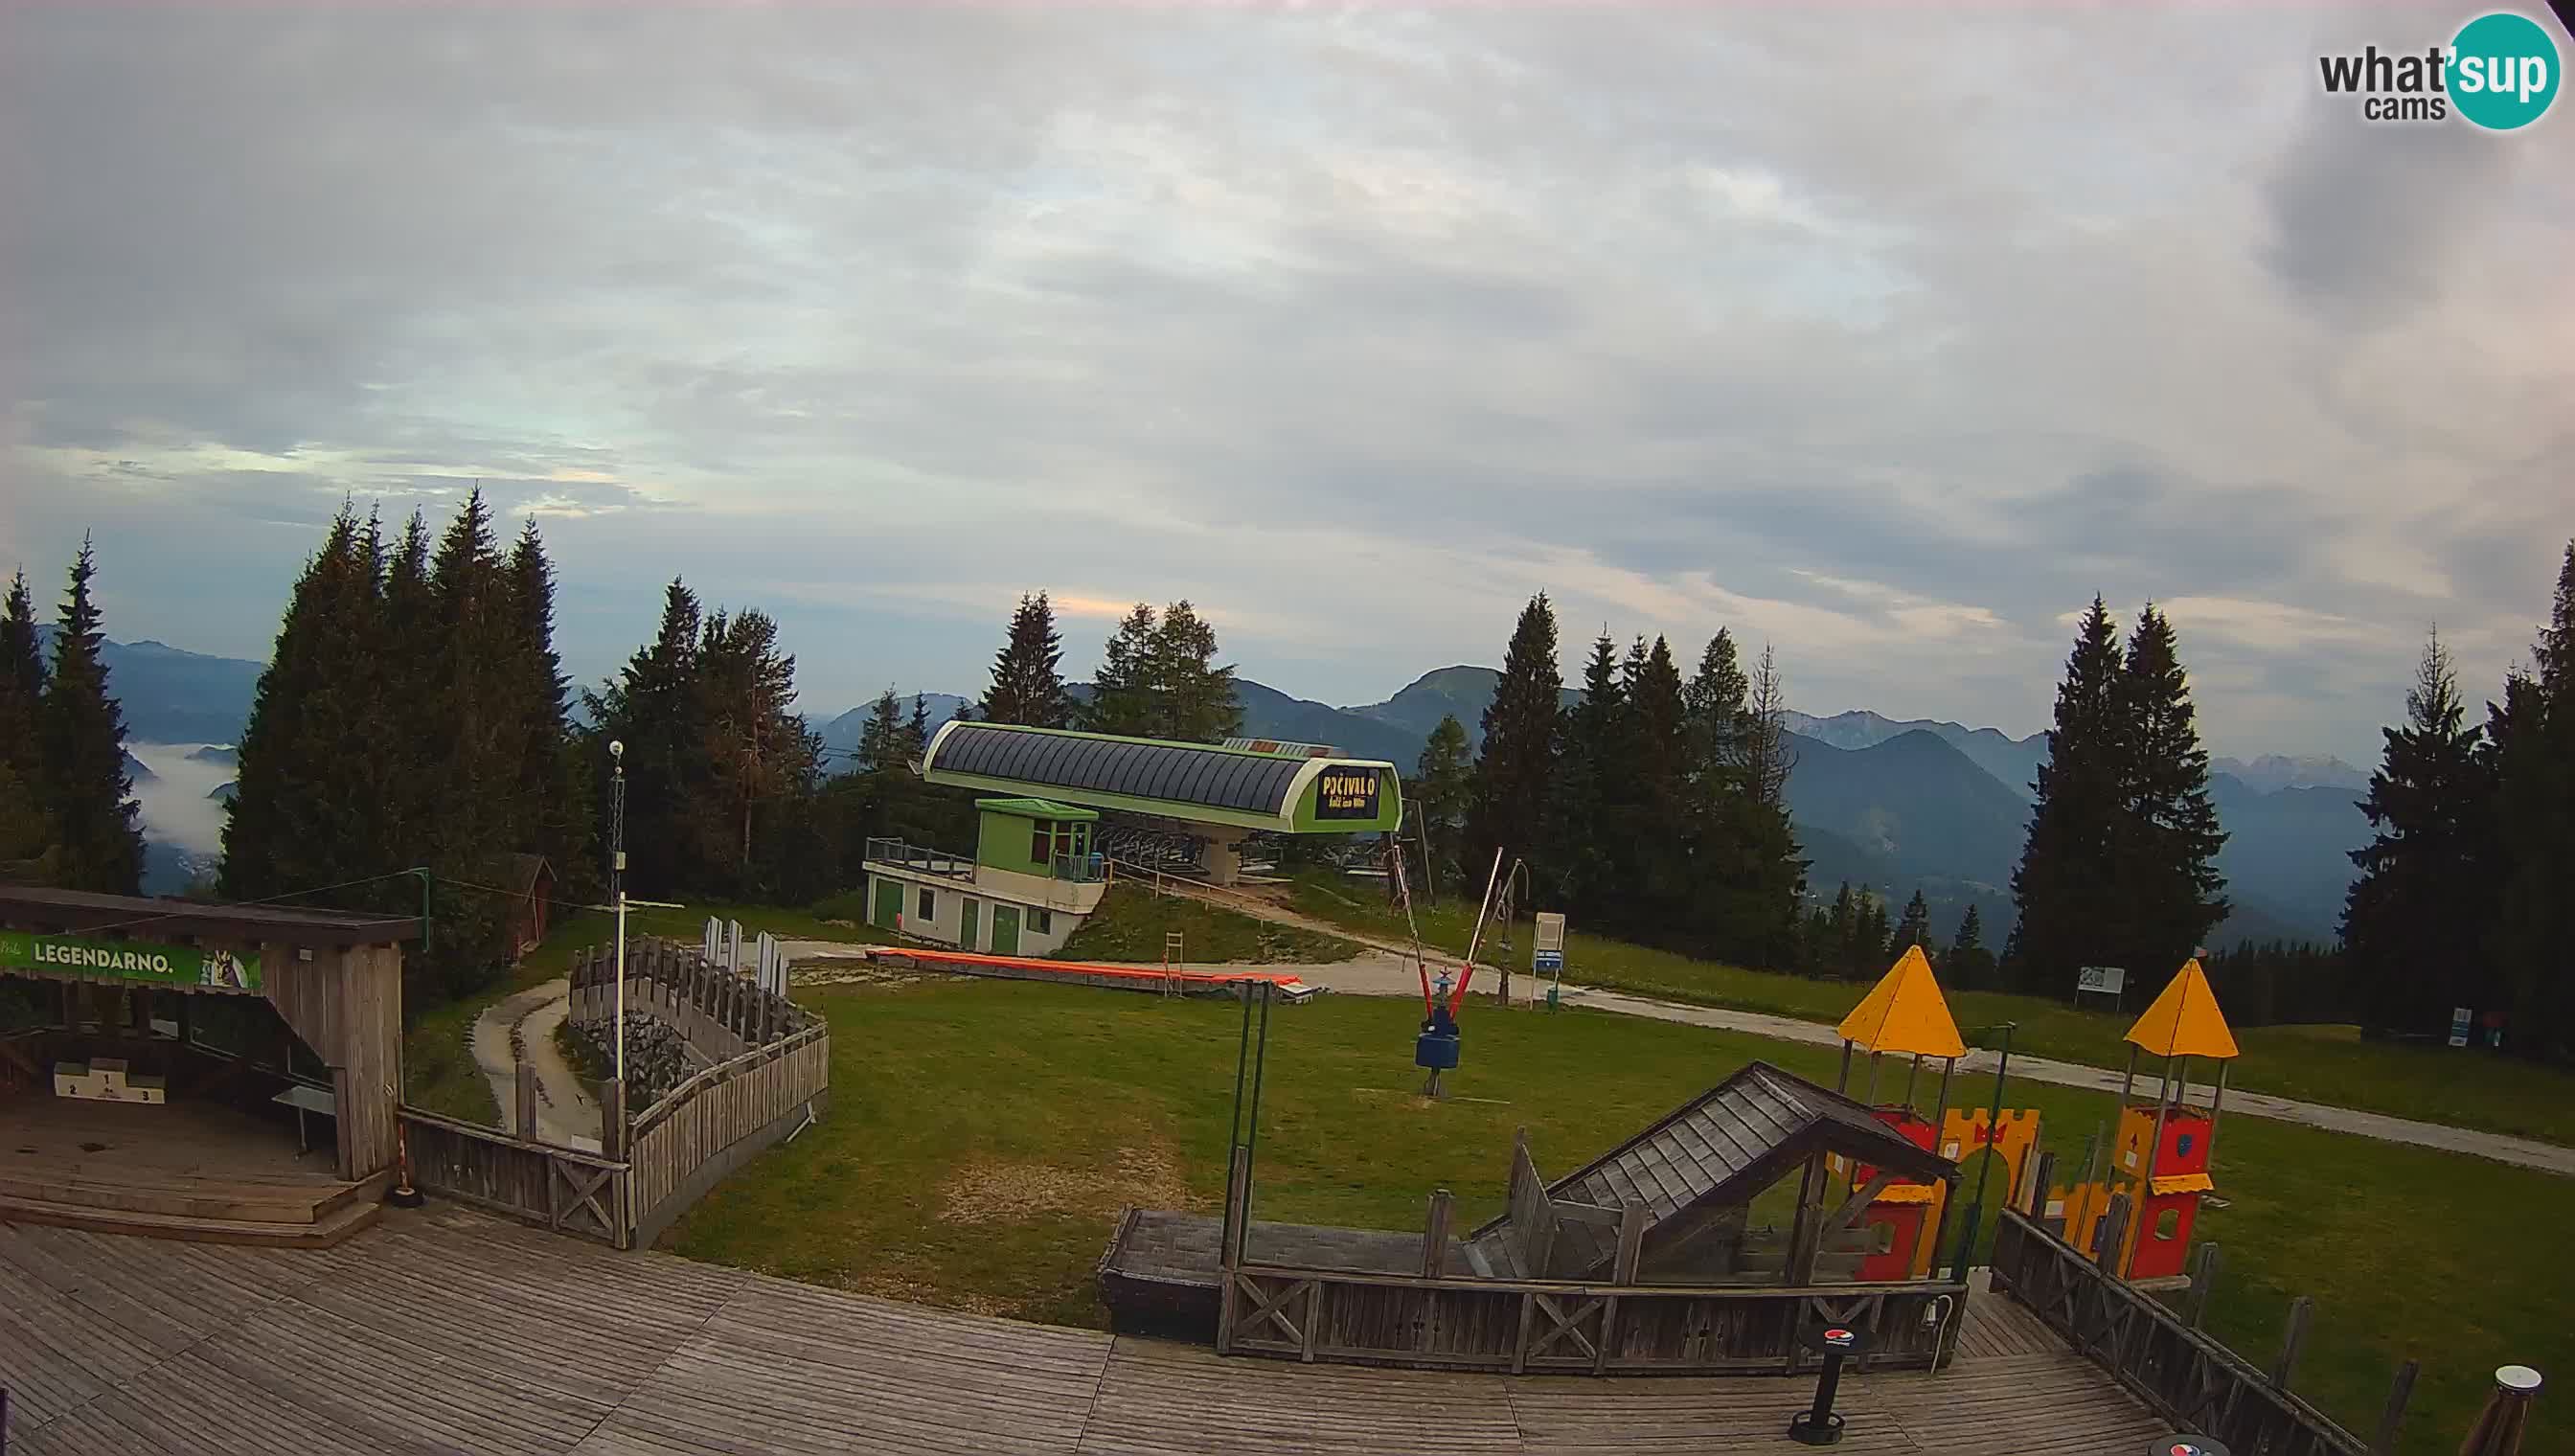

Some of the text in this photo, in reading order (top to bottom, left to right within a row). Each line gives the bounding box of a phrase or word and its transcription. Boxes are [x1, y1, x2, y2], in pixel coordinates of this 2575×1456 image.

[34, 943, 173, 973] LEGENDARNO.
[103, 1073, 110, 1084] 1
[69, 1084, 77, 1095] 2
[142, 1091, 149, 1101] 3
